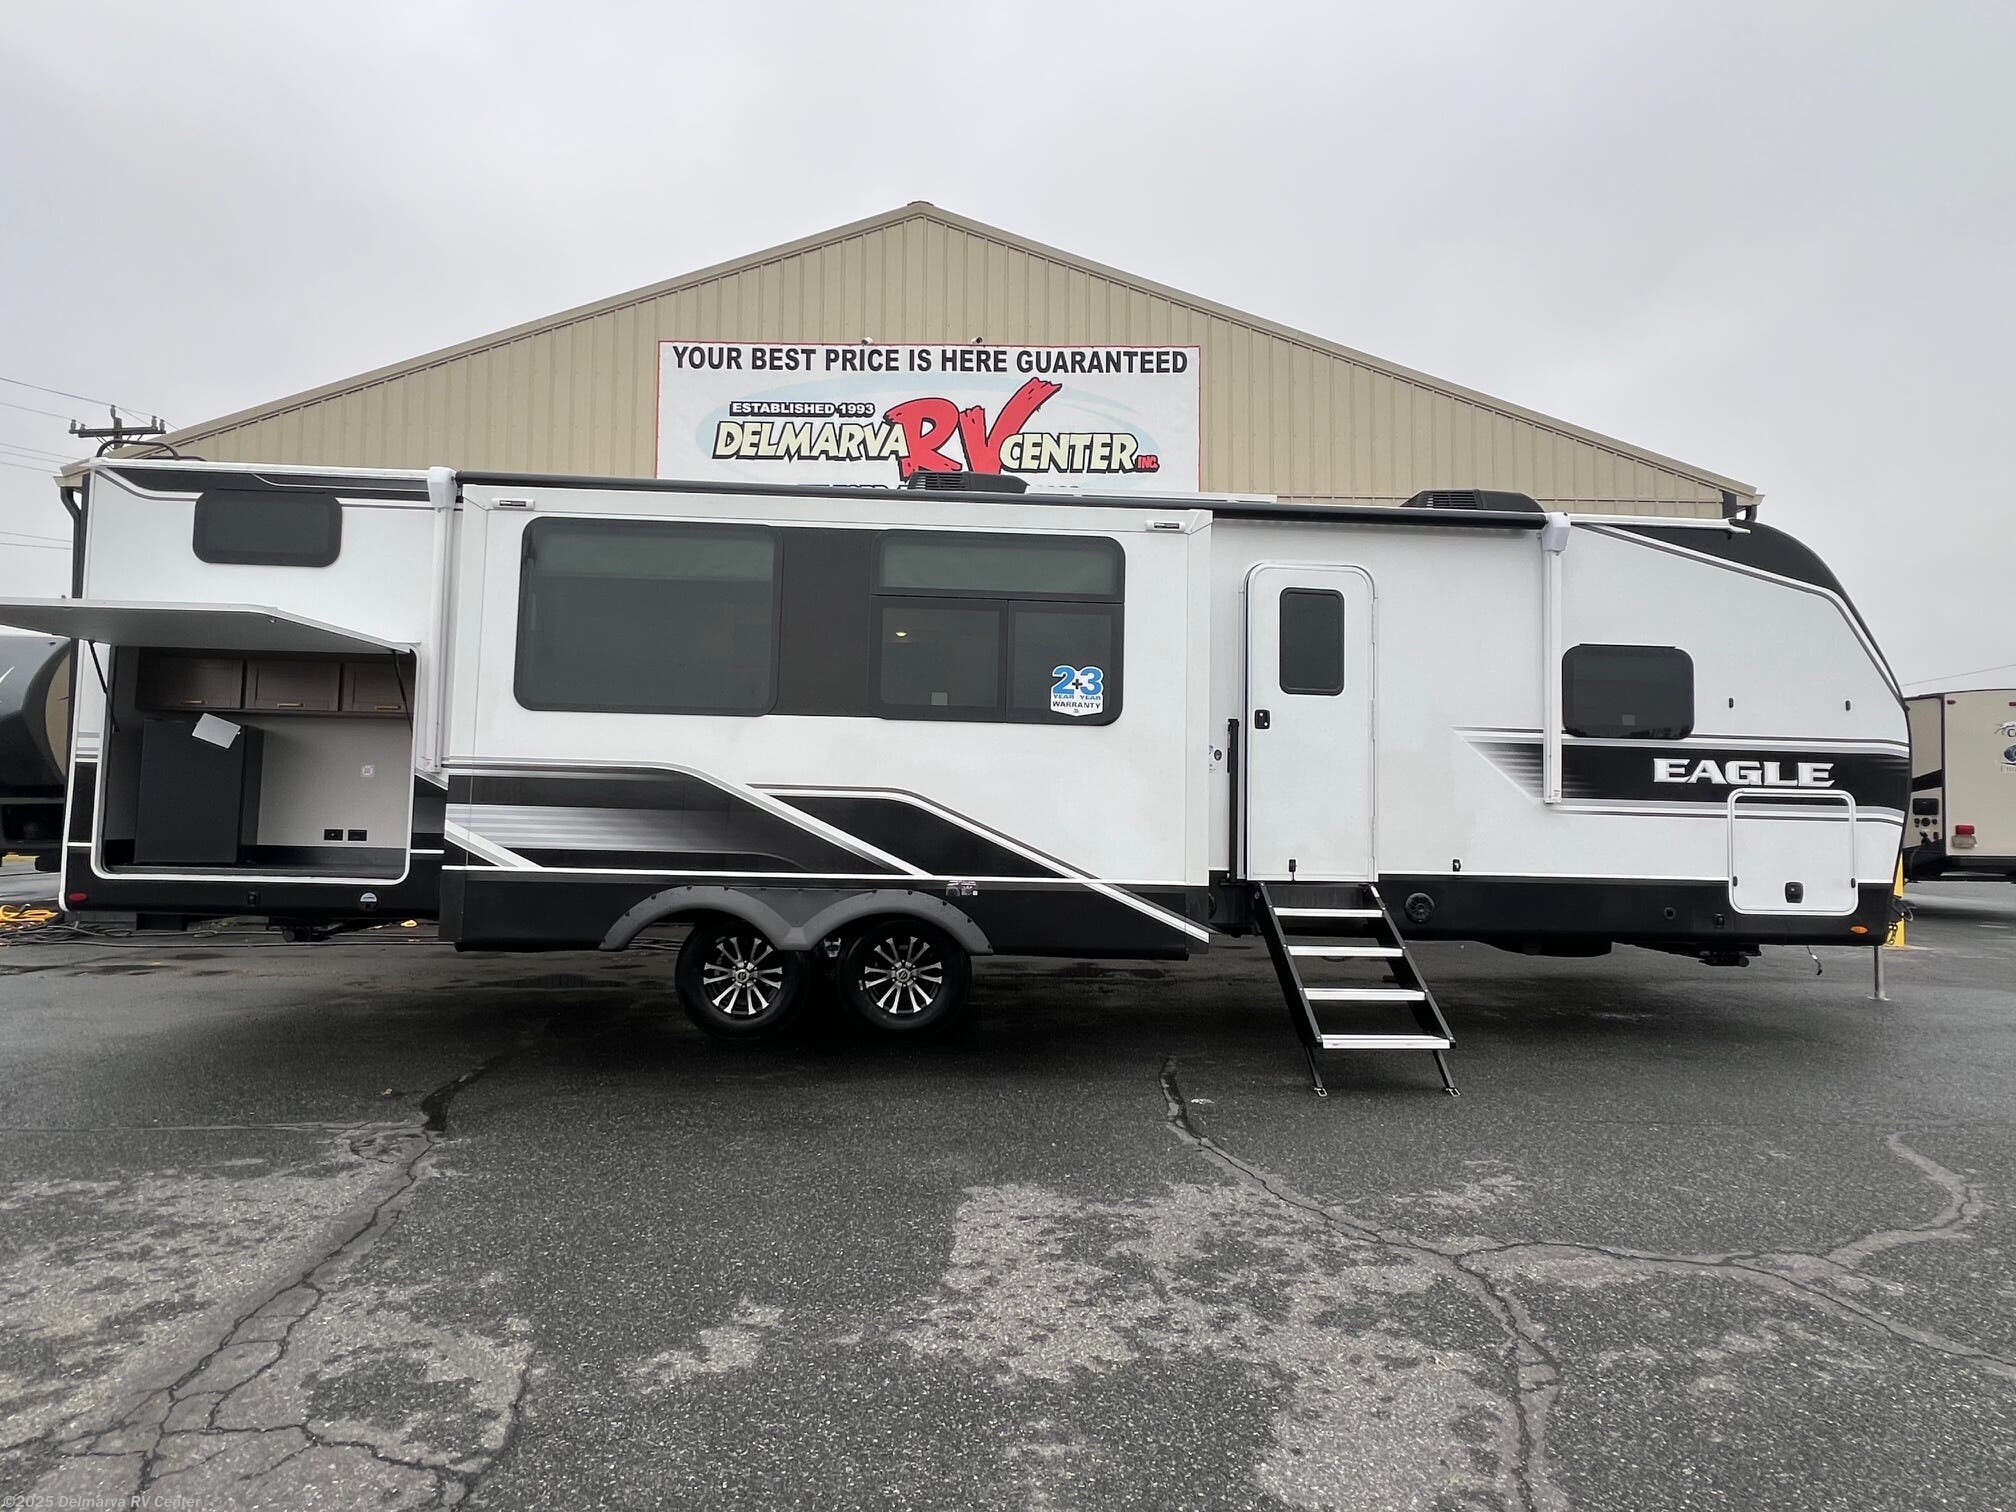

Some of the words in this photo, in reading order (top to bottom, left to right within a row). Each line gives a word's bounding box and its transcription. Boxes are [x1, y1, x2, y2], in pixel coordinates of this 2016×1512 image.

[673, 345, 743, 370] YOUR
[751, 348, 816, 371] BEST
[825, 348, 899, 372] PRICE
[909, 349, 932, 372] IS
[941, 349, 1008, 372] HERE
[1016, 350, 1188, 374] GUARANTEED
[732, 402, 835, 415] ESTABLISHED
[838, 402, 875, 415] 1993
[713, 421, 911, 460] DELMARVA
[883, 377, 1063, 482] RV
[999, 432, 1138, 473] CENTER
[1052, 701, 1100, 709] WARRANTY
[1653, 758, 1835, 788] EAGLE
